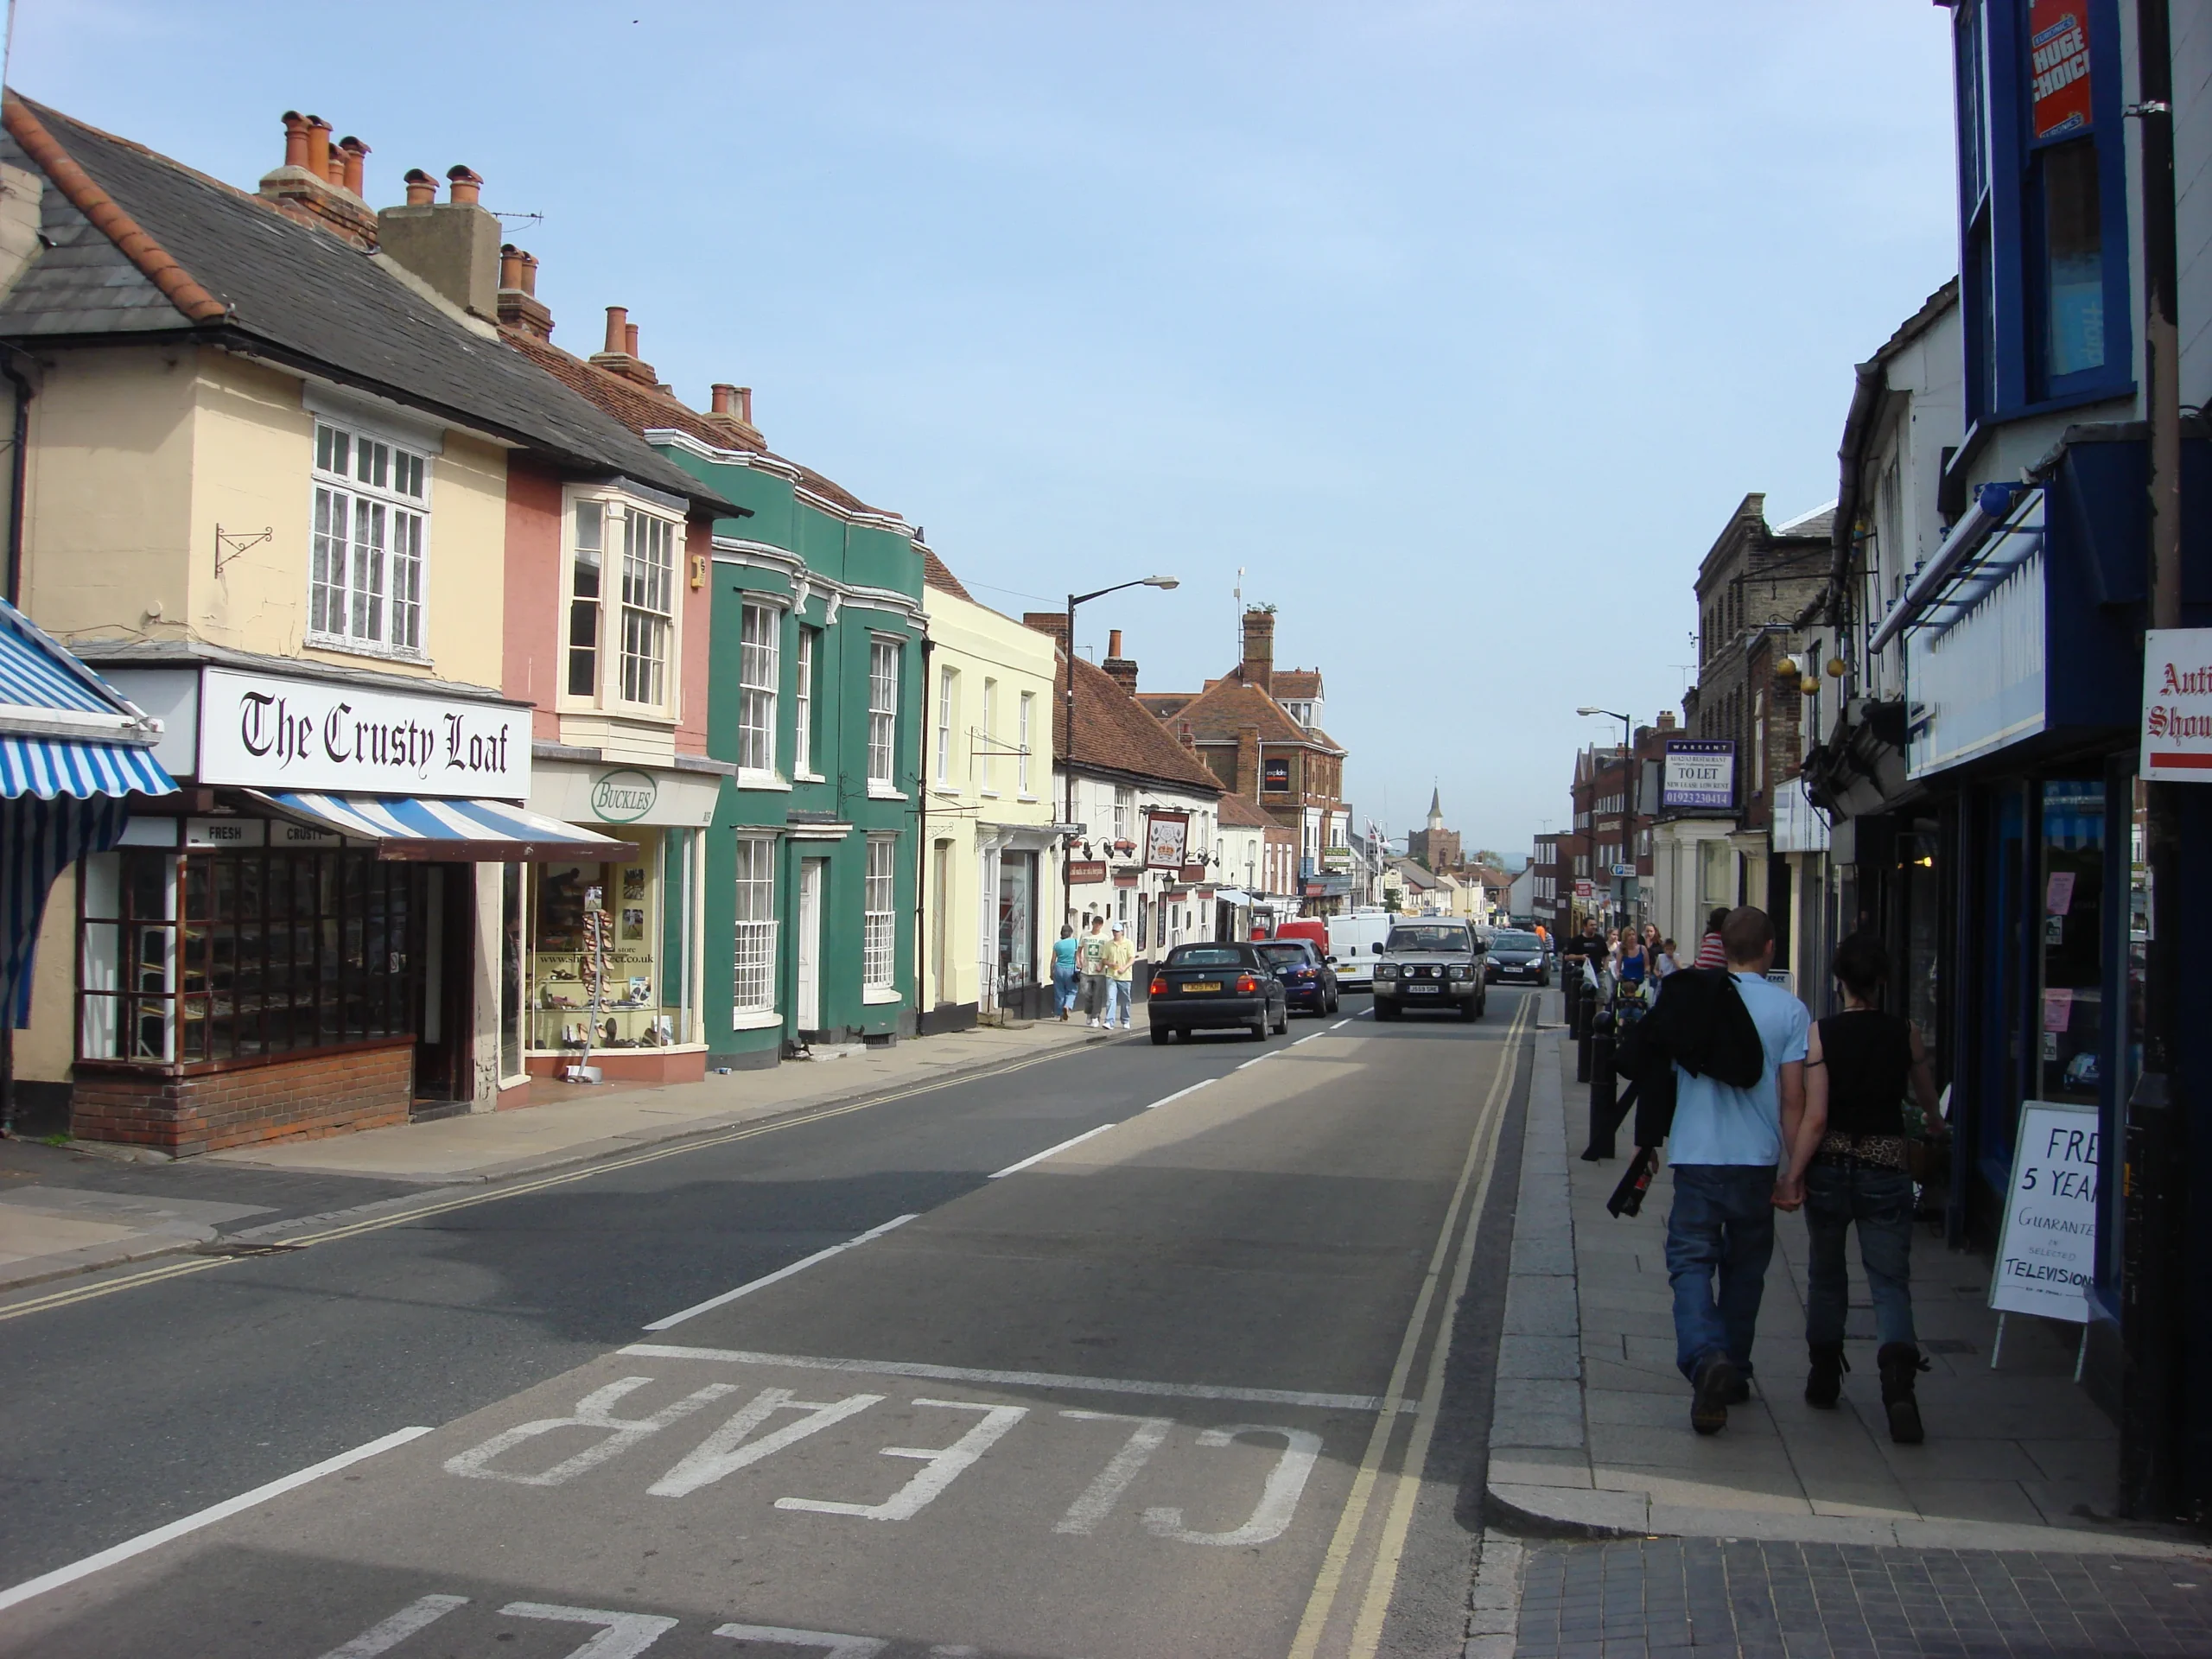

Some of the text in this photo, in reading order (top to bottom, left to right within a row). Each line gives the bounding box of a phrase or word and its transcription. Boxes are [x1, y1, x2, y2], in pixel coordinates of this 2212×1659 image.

[2032, 27, 2084, 74] HUGE
[239, 690, 509, 780] The Crusty Loaf
[1679, 768, 1718, 779] TO LET
[1667, 791, 1727, 804] 01923 230414
[209, 826, 242, 840] FRESH
[2021, 1167, 2097, 1204] 5 YEA
[2029, 1245, 2076, 1262] SELECTED
[442, 1376, 1325, 1547] CLEAR
